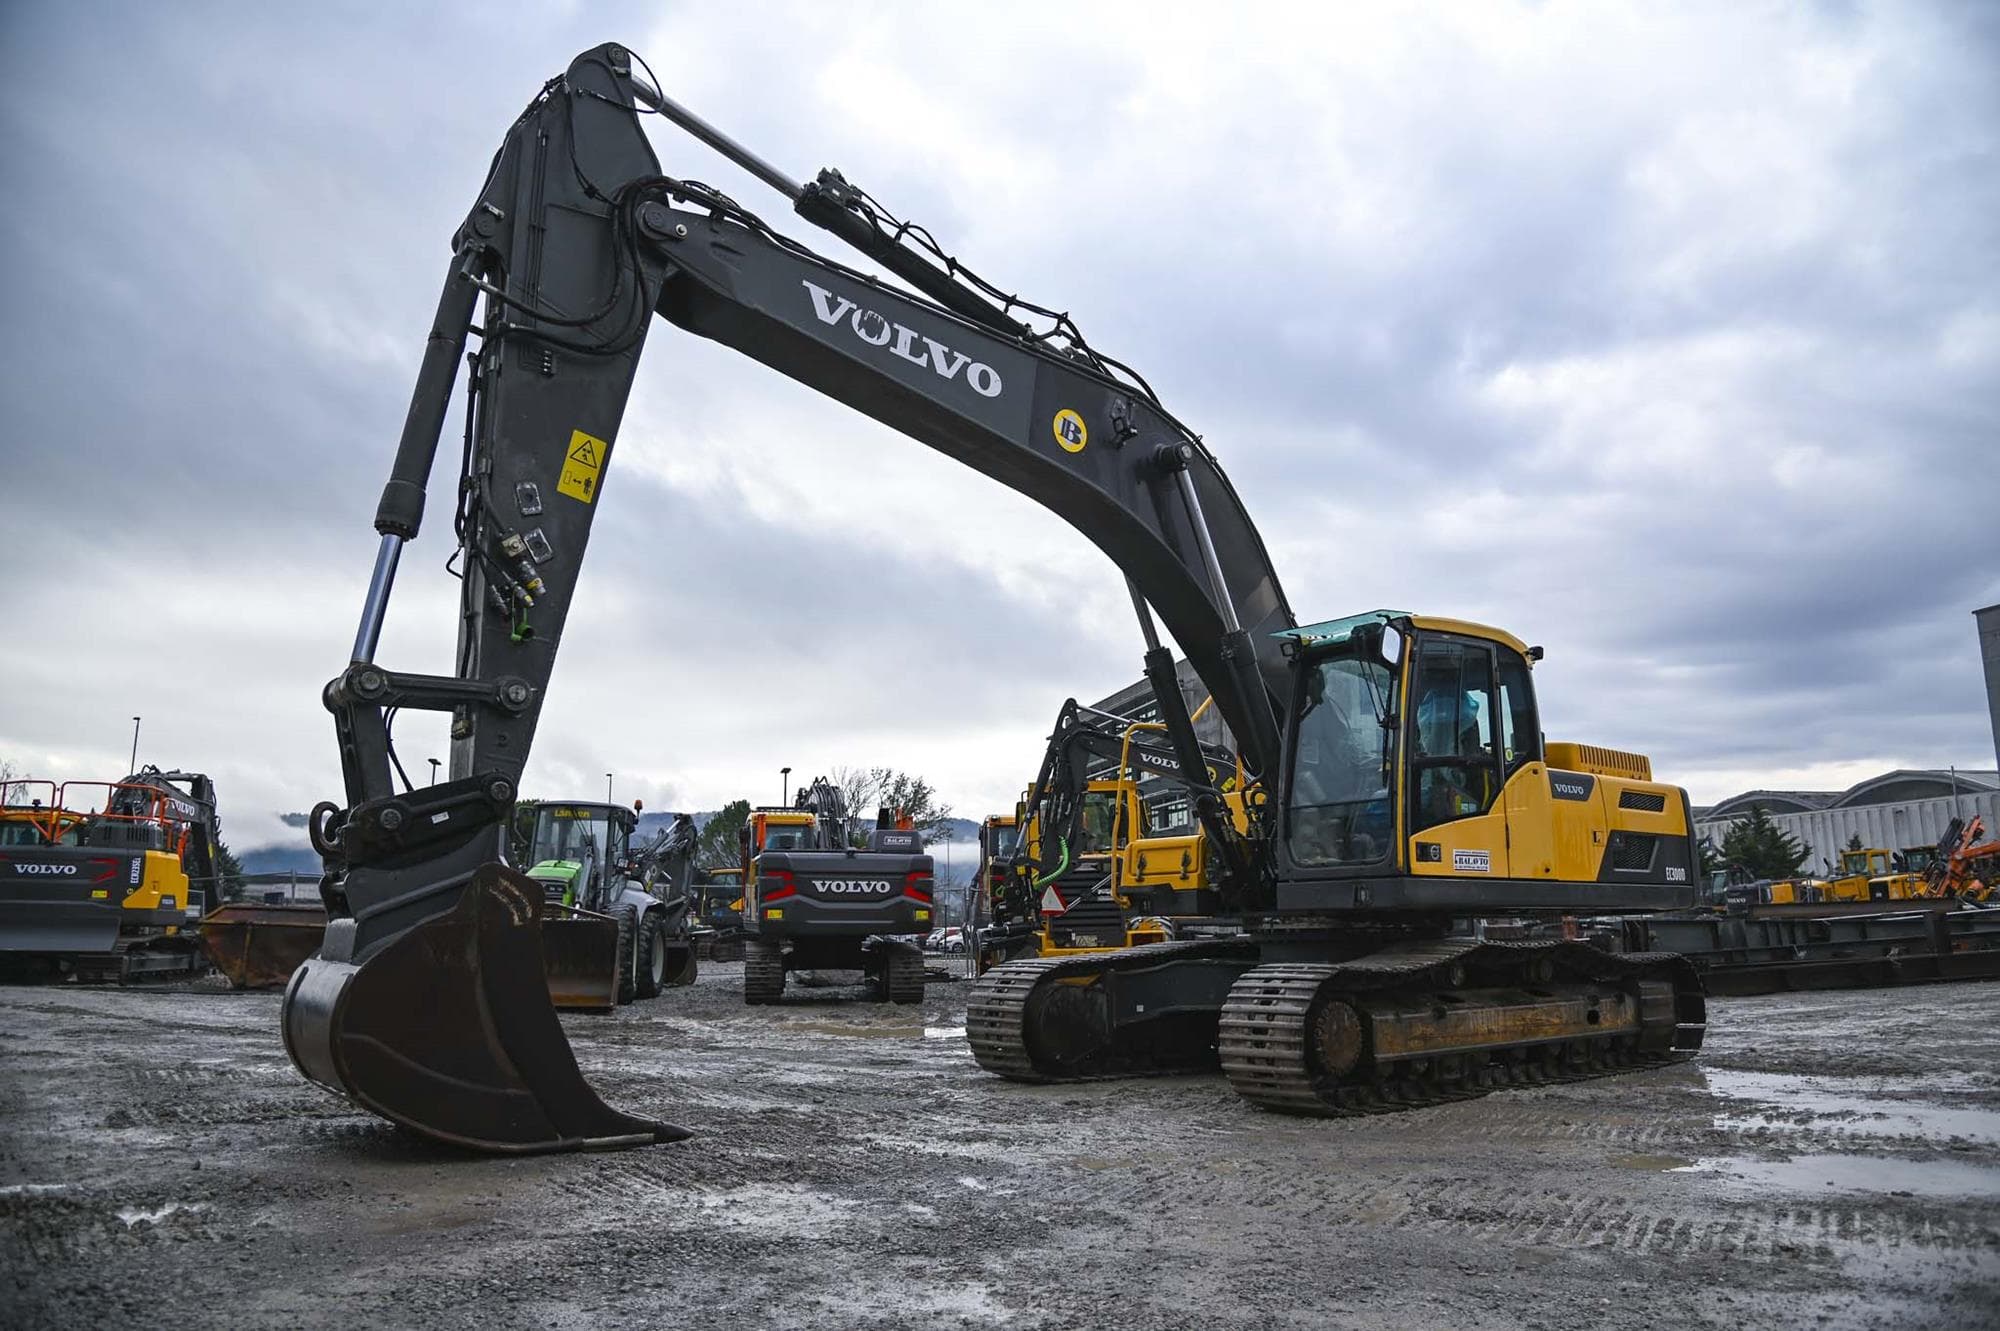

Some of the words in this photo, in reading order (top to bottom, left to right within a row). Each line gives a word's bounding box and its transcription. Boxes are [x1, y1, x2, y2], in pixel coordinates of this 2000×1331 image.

[802, 280, 1002, 397] VOLVO
[1140, 752, 1180, 769] VOLV
[1554, 783, 1584, 795] VOLVO
[15, 864, 77, 875] VOLVO
[1666, 866, 1686, 881] EC300D
[812, 880, 891, 893] VOLVO
